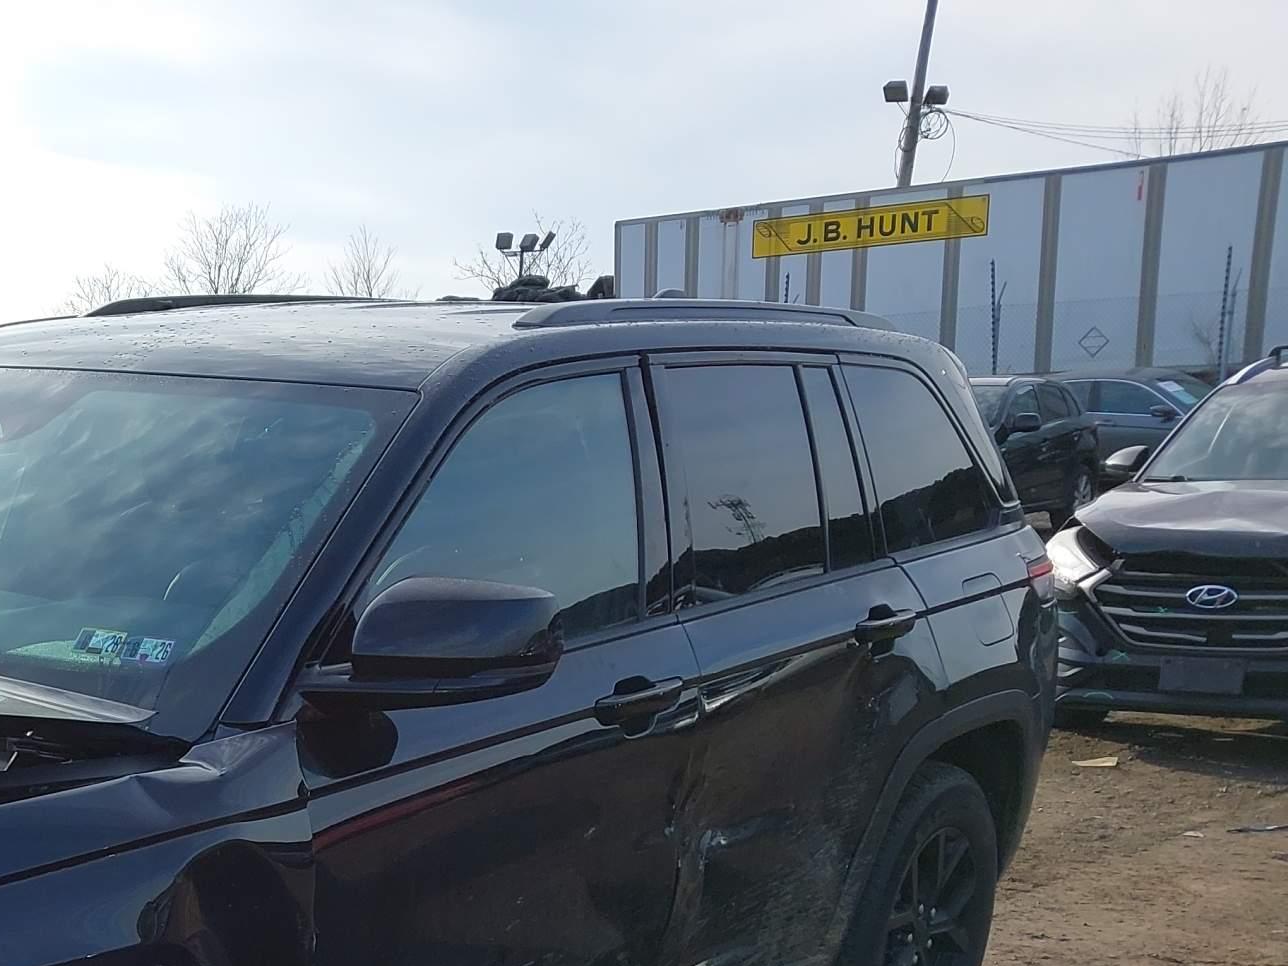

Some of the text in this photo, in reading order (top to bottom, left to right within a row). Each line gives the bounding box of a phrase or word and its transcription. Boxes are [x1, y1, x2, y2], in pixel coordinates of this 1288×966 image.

[796, 209, 940, 246] J.B. HUNT
[155, 641, 172, 661] 26
